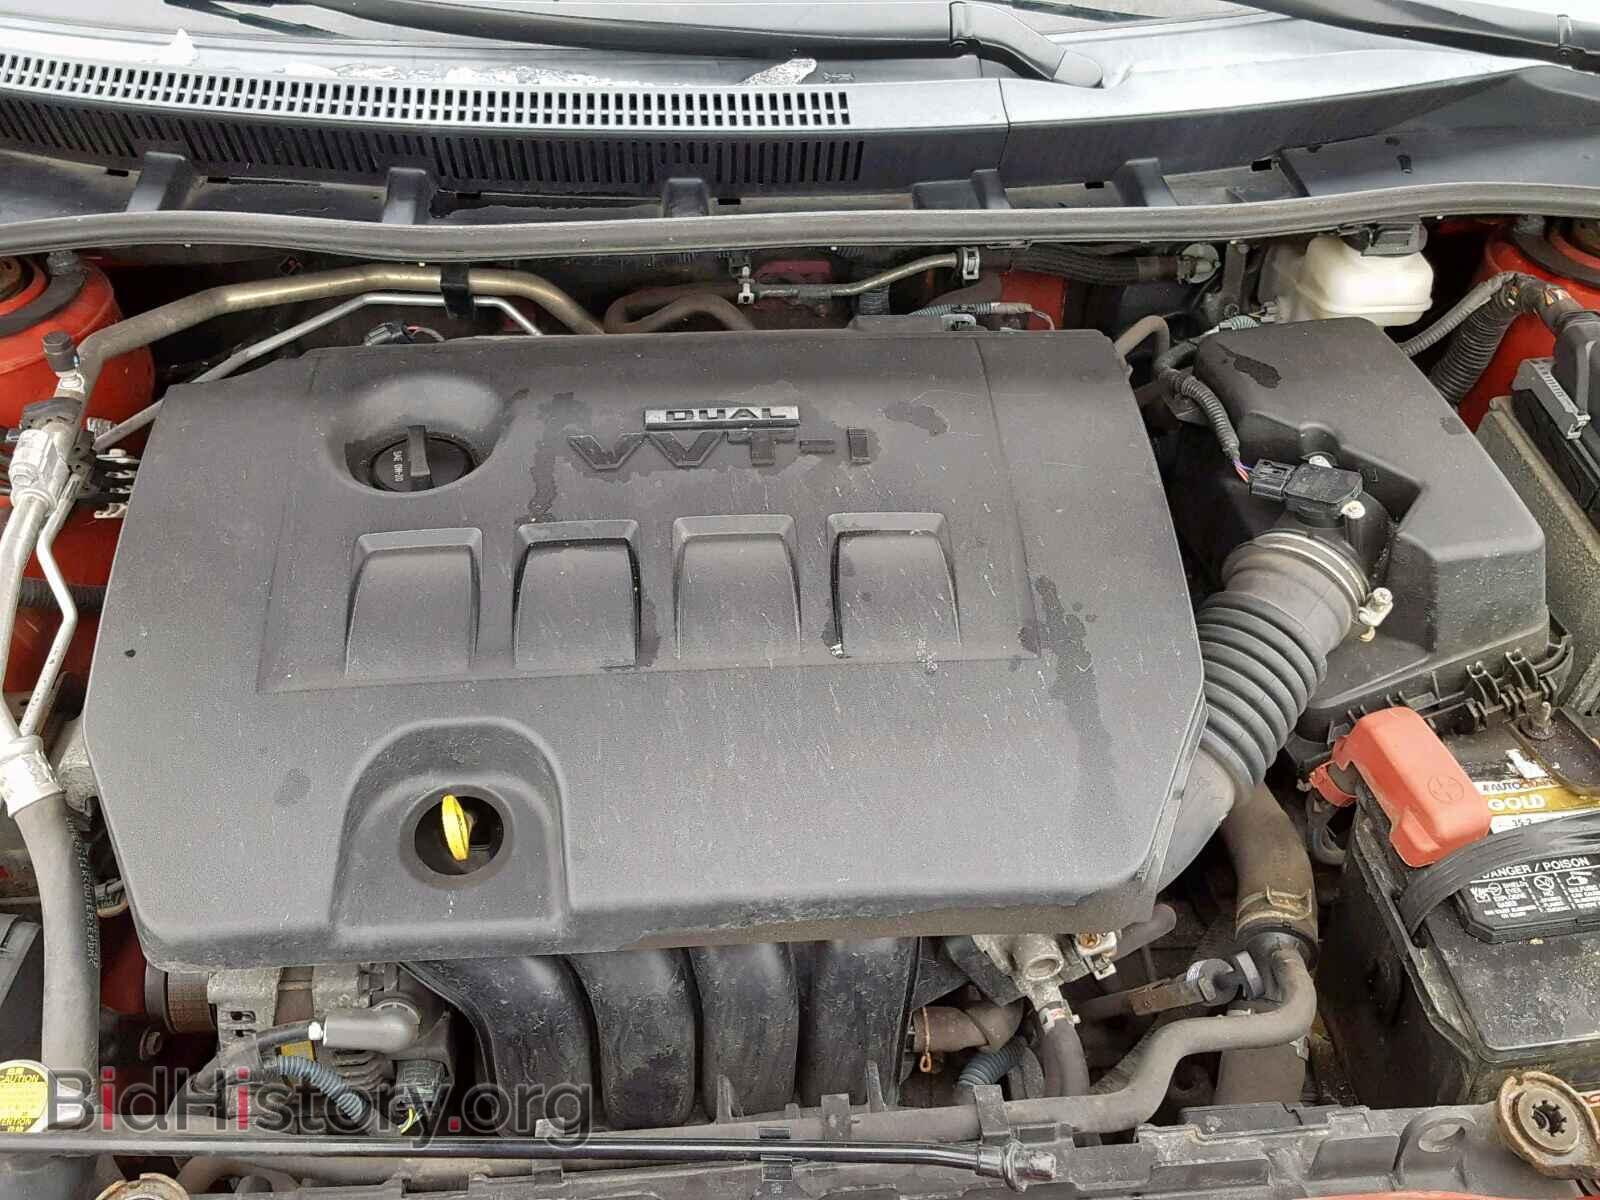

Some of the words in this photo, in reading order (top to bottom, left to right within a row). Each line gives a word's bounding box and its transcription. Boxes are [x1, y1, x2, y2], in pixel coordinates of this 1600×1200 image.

[665, 407, 788, 422] DUAL
[393, 450, 402, 462] SAE
[394, 463, 404, 482] 0W-20
[1487, 794, 1546, 811] GOLD
[1542, 856, 1591, 871] POISON
